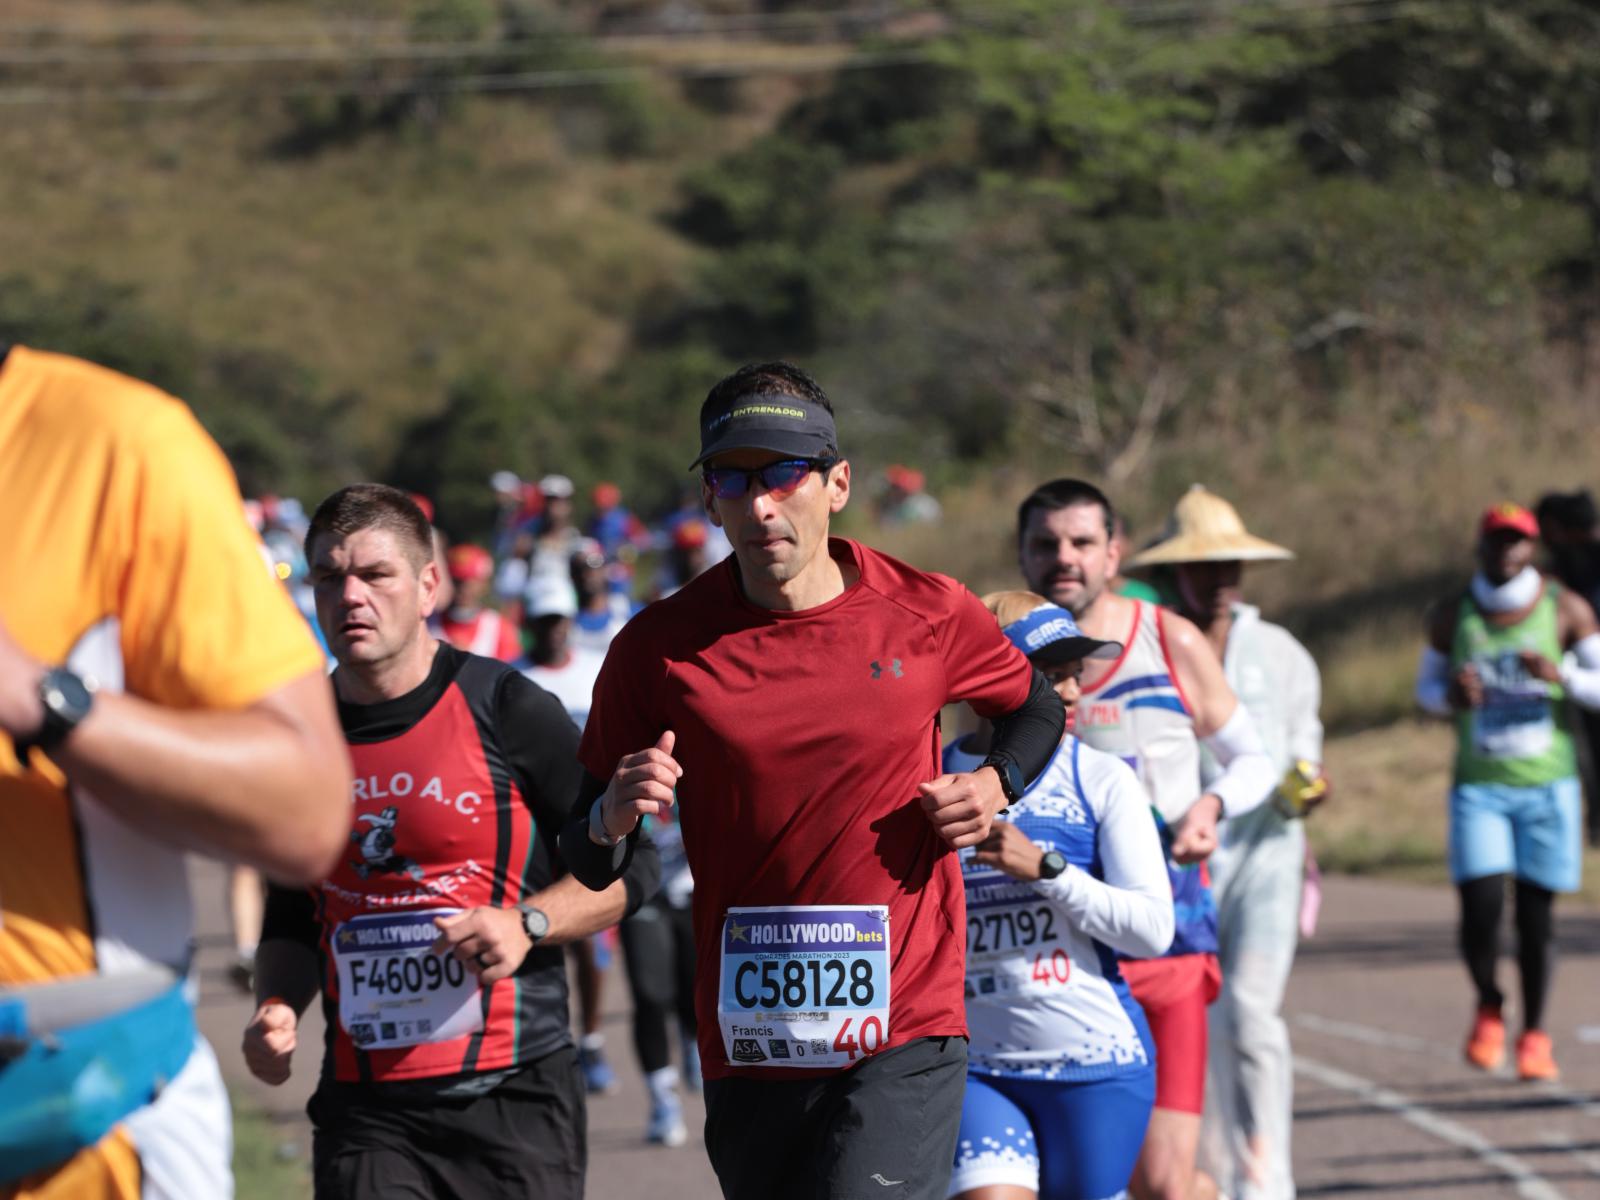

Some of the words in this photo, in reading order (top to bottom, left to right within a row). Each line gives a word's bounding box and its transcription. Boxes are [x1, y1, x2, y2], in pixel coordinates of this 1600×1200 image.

[733, 406, 804, 418] ENTRENADOR
[965, 906, 1057, 953] 27192
[350, 951, 464, 997] F46090
[734, 958, 874, 1009] C58128
[1032, 947, 1070, 986] 40
[731, 1024, 774, 1037] Francis
[734, 1040, 761, 1055] ASA
[832, 1015, 883, 1061] 40
